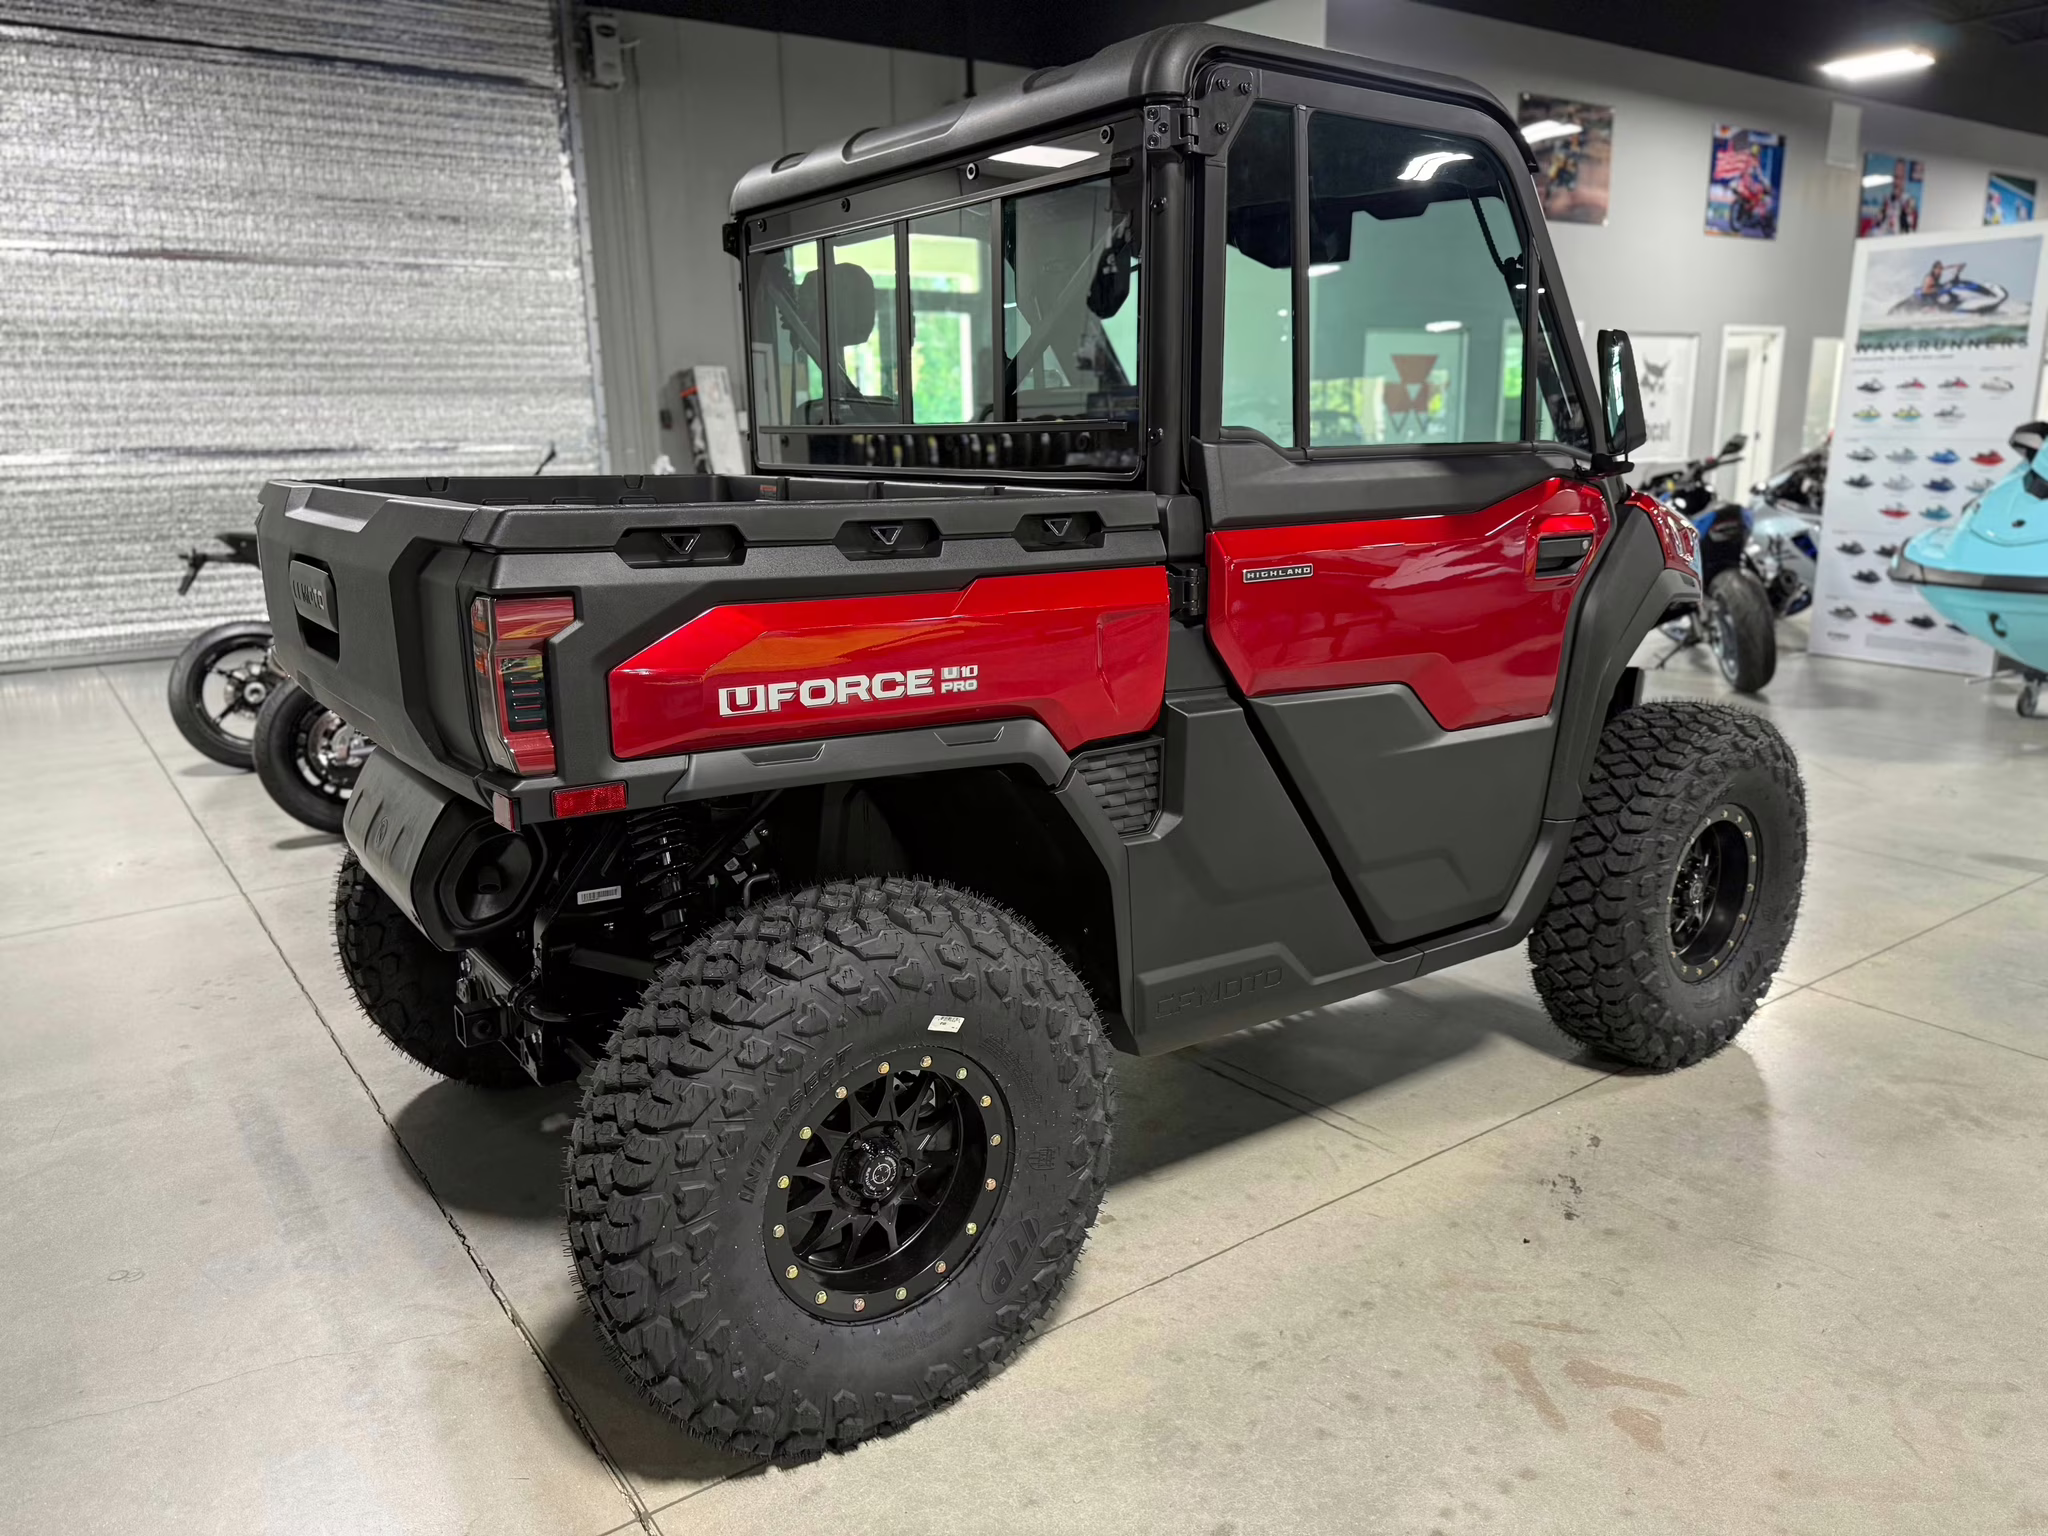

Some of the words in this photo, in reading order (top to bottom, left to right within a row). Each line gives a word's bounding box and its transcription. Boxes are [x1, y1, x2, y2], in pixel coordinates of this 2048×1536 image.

[1854, 336, 2029, 355] WAVERUNNERS
[1246, 567, 1311, 579] HIGHLAND
[941, 664, 979, 680] U10
[941, 679, 978, 694] PRO
[718, 668, 934, 718] UFORCE
[1155, 967, 1283, 1020] CFMOTO
[738, 1042, 854, 1204] INTERSECT
[992, 1217, 1038, 1296] ITP
